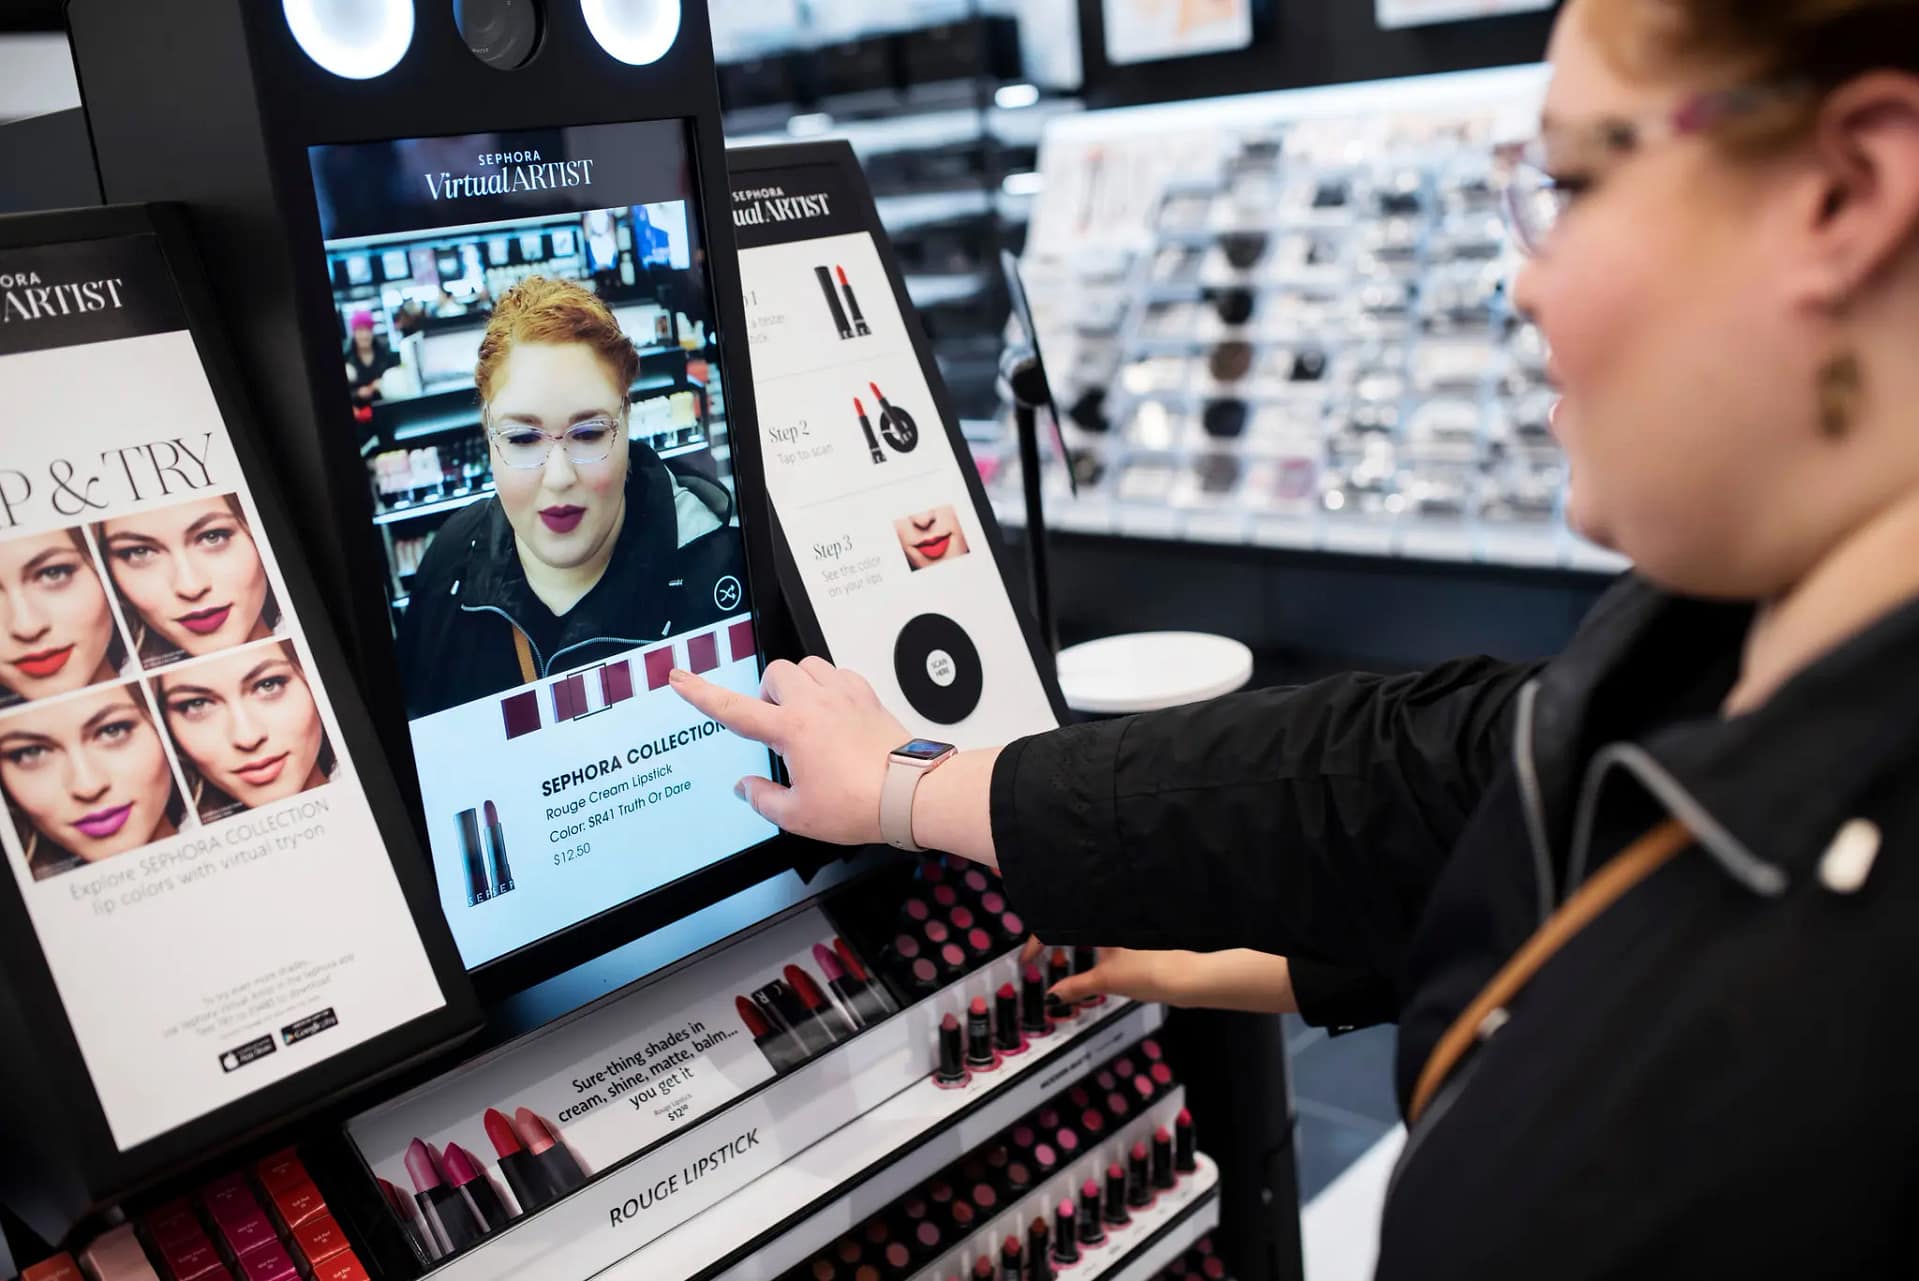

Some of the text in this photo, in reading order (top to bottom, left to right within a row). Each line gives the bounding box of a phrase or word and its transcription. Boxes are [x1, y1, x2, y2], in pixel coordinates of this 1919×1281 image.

[478, 150, 541, 166] SEPHORA
[731, 186, 784, 202] SEPHORA
[4, 278, 122, 322] ARTIST
[769, 419, 810, 444] Step 2
[49, 459, 109, 516] &
[100, 432, 215, 501] TRY
[813, 534, 853, 560] Step 3
[542, 755, 622, 797] SEPHORA
[546, 763, 673, 820] Rouge Cream Lipstick
[549, 780, 692, 843] Color: SR41 Truth Or Dare
[69, 868, 136, 901] Explore
[140, 837, 222, 877] SEPHORA
[225, 799, 329, 845] COLLECTION
[120, 878, 174, 906] colors
[179, 860, 216, 884] with
[221, 839, 272, 869] virtual
[275, 823, 325, 849] try-on
[553, 842, 591, 866] $12.50
[572, 1021, 706, 1093] Sure-thing shades in
[558, 1094, 608, 1122] cream,
[607, 1072, 650, 1098] shine,
[649, 1049, 695, 1076] matte,
[629, 1067, 694, 1110] you get it
[609, 1128, 760, 1228] ROUGE LIPSTICK
